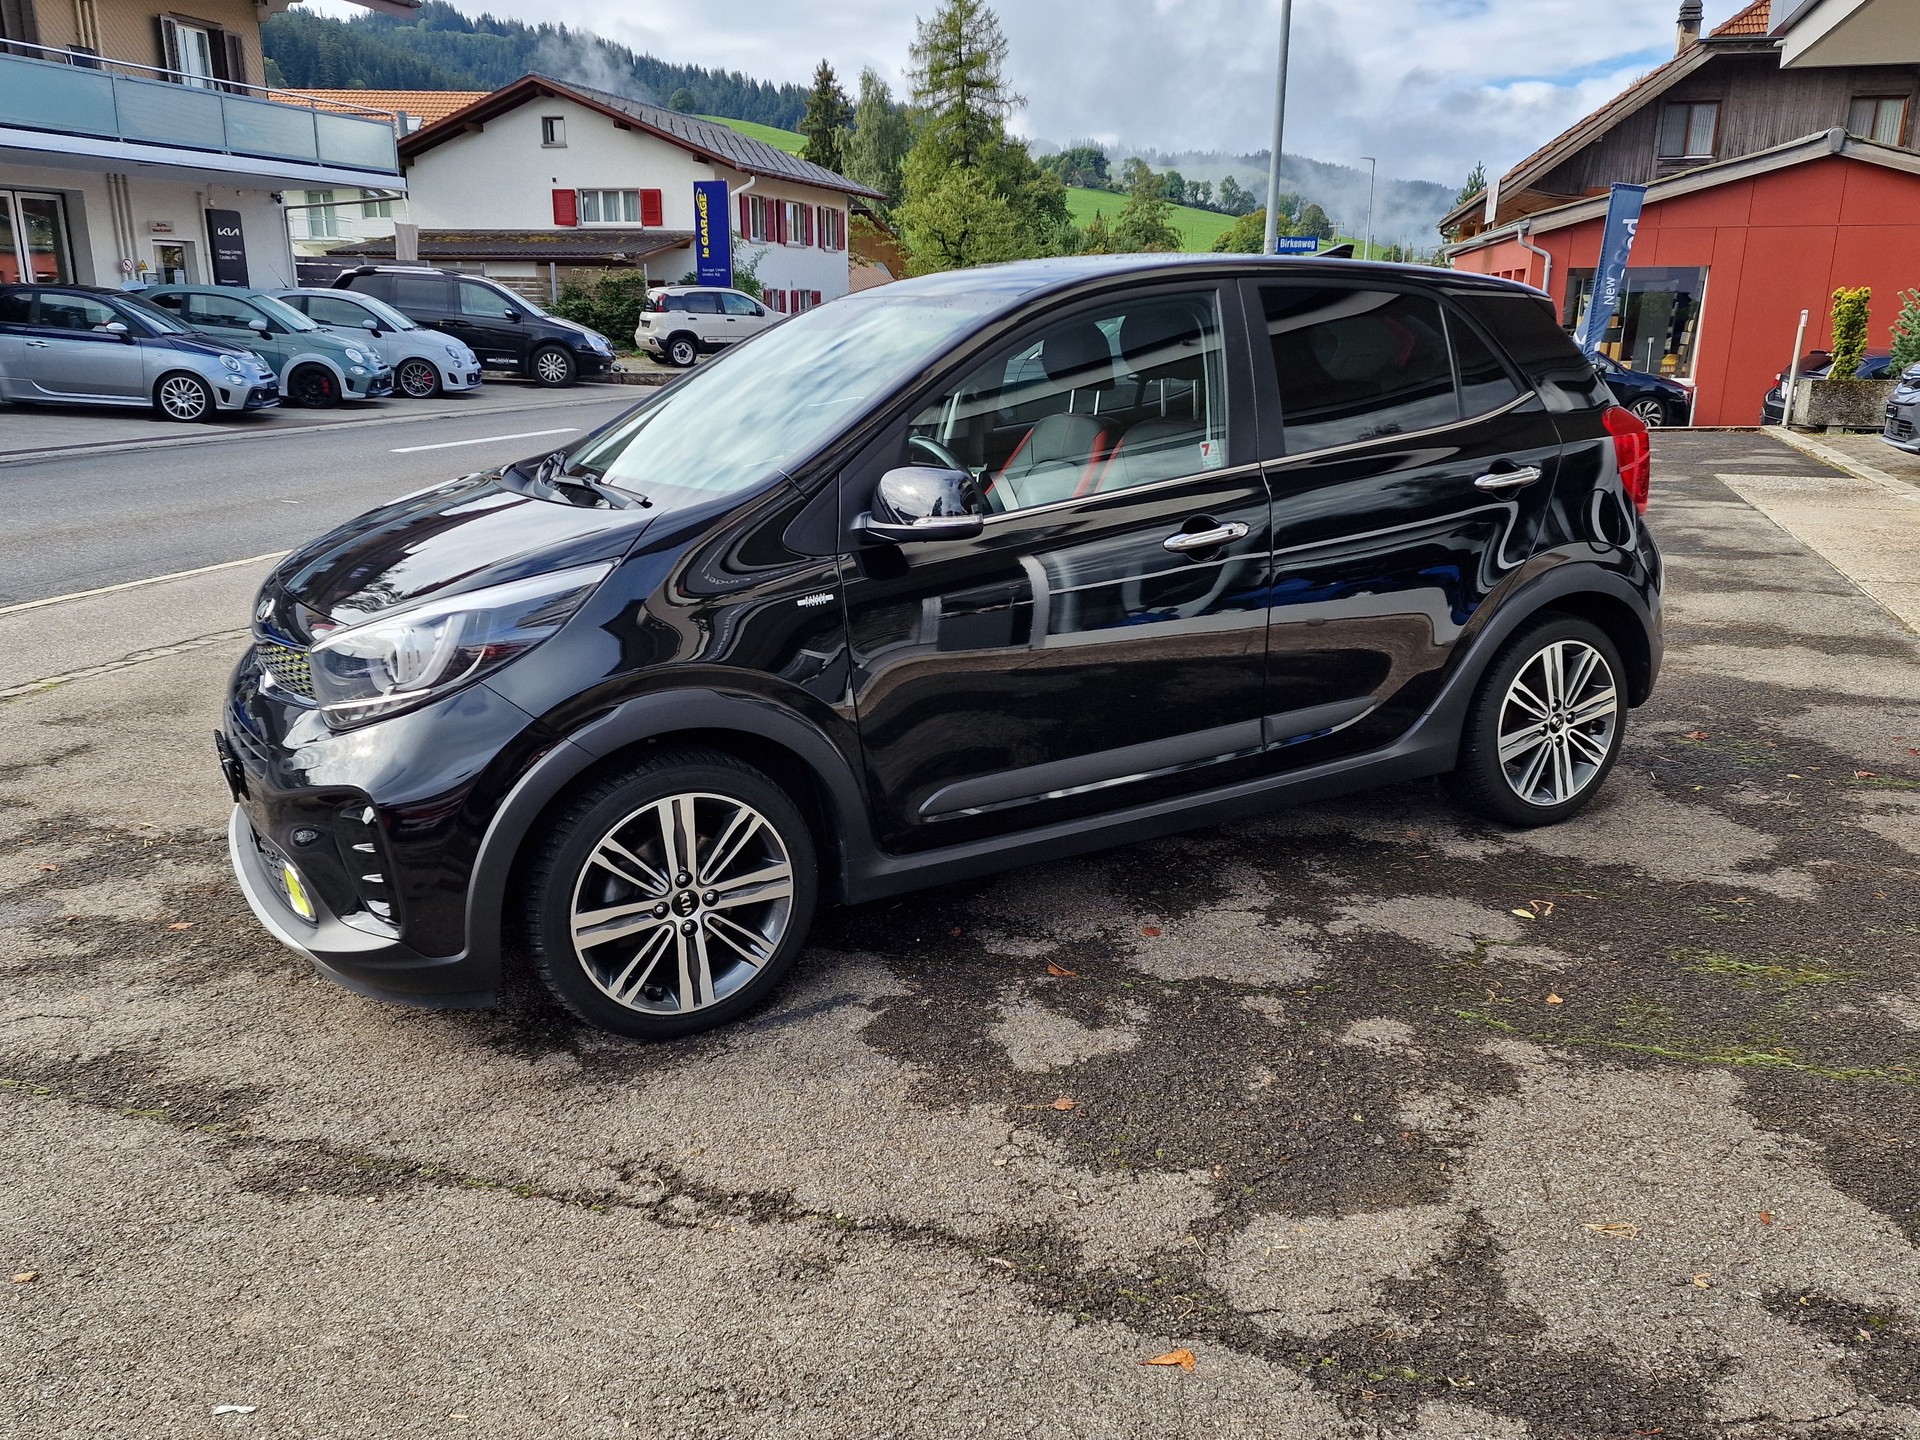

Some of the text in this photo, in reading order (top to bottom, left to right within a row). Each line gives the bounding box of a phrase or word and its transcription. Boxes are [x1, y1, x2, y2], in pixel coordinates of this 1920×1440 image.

[217, 227, 240, 236] KIA
[699, 193, 710, 258] le GARAGE
[1280, 238, 1316, 250] Birkenweg
[1604, 277, 1616, 305] New
[1201, 443, 1210, 456] 7
[680, 892, 692, 916] KIA
